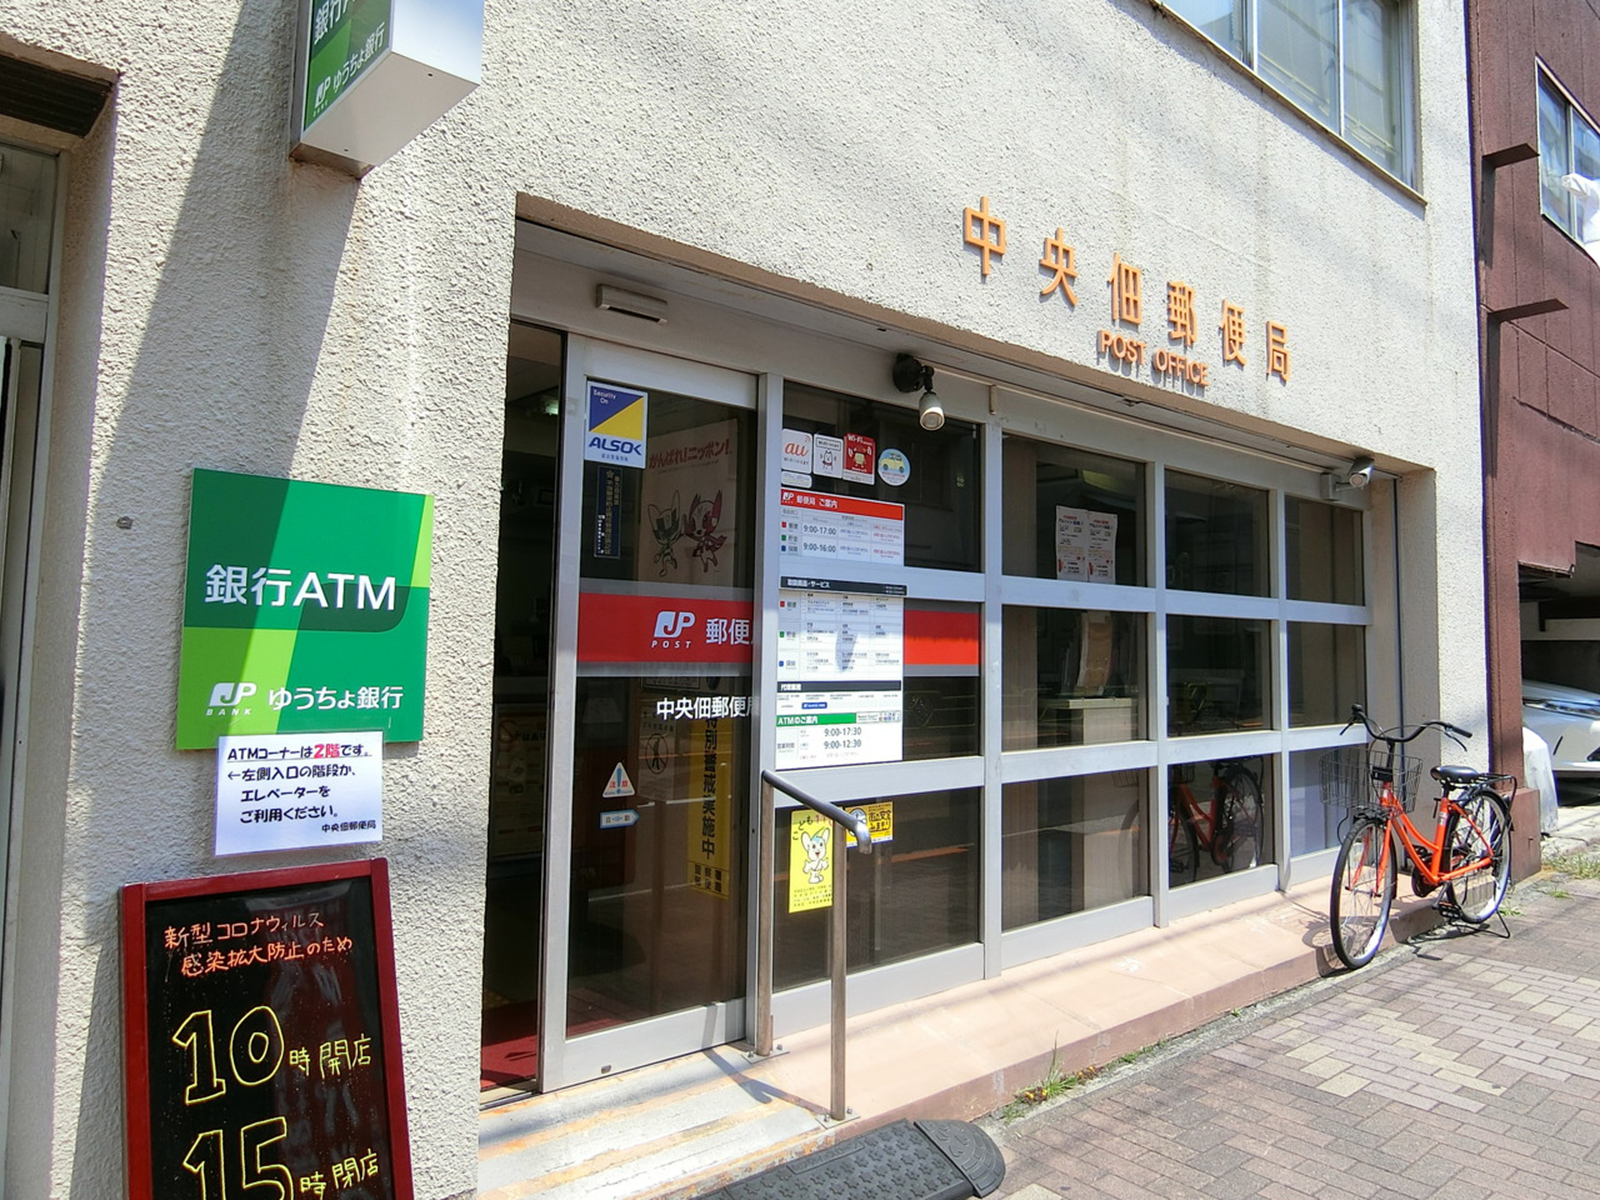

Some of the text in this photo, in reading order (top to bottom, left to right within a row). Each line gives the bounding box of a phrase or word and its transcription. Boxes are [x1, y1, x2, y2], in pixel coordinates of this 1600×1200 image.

[314, 0, 356, 45] 銀行
[333, 21, 385, 93] ゆうちょ銀行
[963, 195, 1291, 382] 中央佃郵便局
[1099, 330, 1210, 387] POST OFFICE
[593, 389, 617, 400] Security
[589, 436, 642, 456] ALSOK
[785, 442, 809, 457] au
[803, 524, 836, 535] 9:00-17:00
[803, 542, 836, 553] 9:00-16:00
[205, 564, 396, 611] 銀行ATM
[706, 618, 754, 645] 郵便
[651, 640, 692, 648] POST
[267, 686, 404, 711] ゆうちょ銀行
[206, 708, 252, 716] BANK
[777, 715, 819, 725] ATMのご案内
[824, 727, 862, 737] 9:00-17:30
[227, 743, 369, 761] ATMコーナーは2階です。
[823, 739, 862, 750] 9:00-12:30
[240, 785, 331, 802] エレベーターを
[240, 805, 338, 824] ご利用ください。
[321, 820, 377, 833] 中央佃郵便局
[164, 912, 325, 949] 新型コロナウィルス
[180, 936, 353, 977] 感染拡大防止のため
